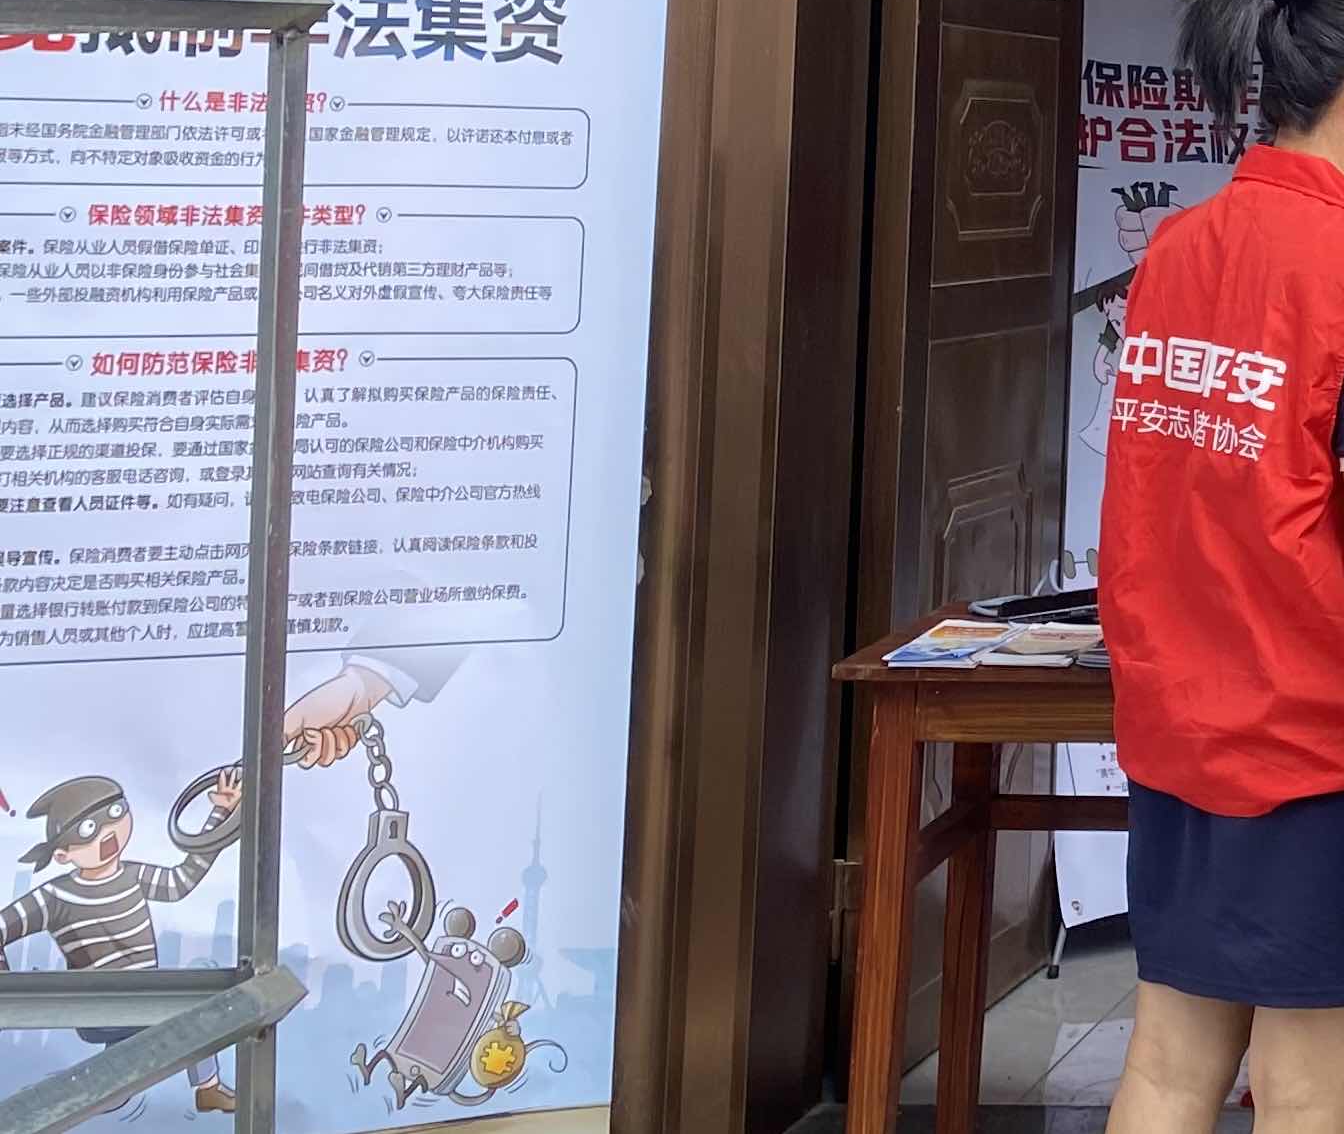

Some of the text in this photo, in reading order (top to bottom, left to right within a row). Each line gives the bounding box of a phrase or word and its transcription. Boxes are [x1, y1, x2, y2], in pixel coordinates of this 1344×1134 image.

[159, 90, 328, 113] 什么是非法资？
[1078, 113, 1276, 165] 护合法权
[87, 204, 366, 227] 保险领域非法集资类型？
[91, 349, 348, 375] 如何防范保险非集资？
[1118, 331, 1288, 411] 中国平安
